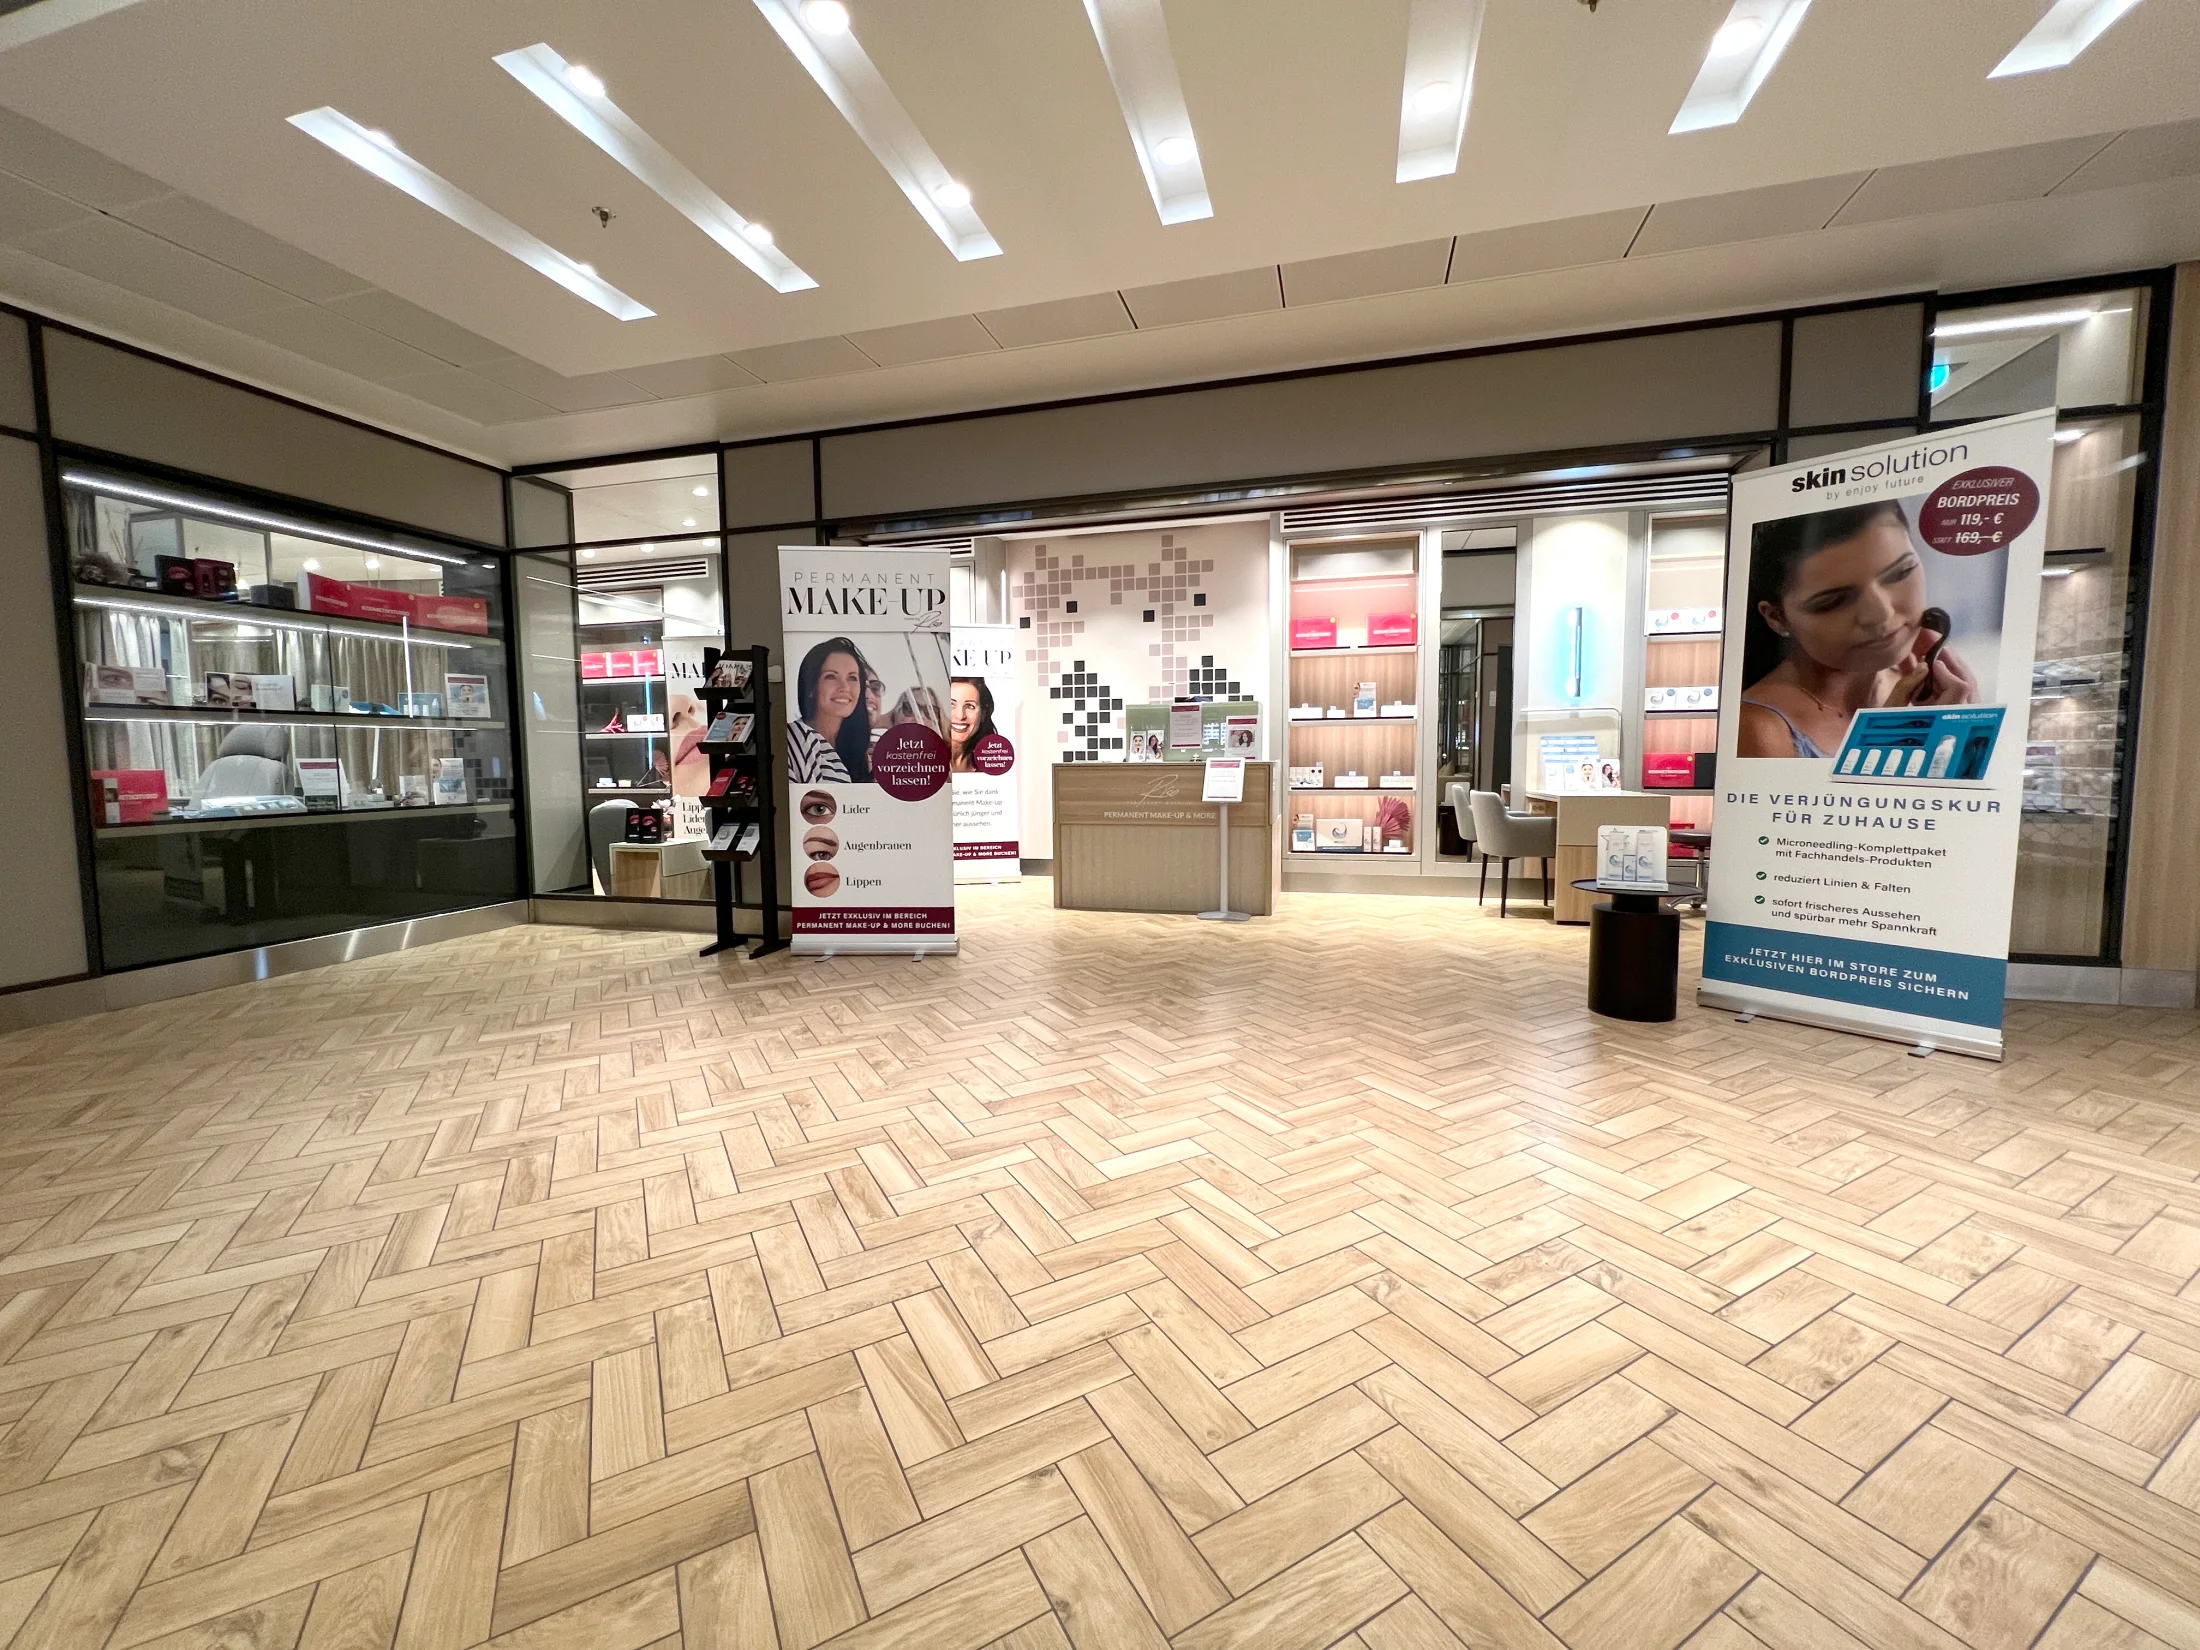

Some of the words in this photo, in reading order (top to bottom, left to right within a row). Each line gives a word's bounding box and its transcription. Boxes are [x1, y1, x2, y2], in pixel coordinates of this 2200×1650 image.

[1792, 467, 1846, 493] skin
[1851, 444, 1968, 482] solution
[1827, 491, 1840, 500] by
[1845, 483, 1879, 497] enjoy
[1885, 476, 1924, 489] future
[1952, 477, 2015, 490] EXKLUSIVER
[1937, 493, 2020, 508] BORDPREIS
[1993, 512, 2004, 525] €
[794, 572, 935, 584] PERMANENT
[787, 587, 946, 616] MAKE-UP
[896, 738, 924, 750] Jetzt
[885, 751, 936, 760] kostenfrei
[877, 762, 945, 773] vorzeichnen
[892, 775, 931, 785] lassen!
[842, 804, 870, 814] Lider
[1727, 793, 1759, 805] DIE
[1769, 793, 2001, 813] VERJÜNGUNGSKUR
[1772, 810, 1812, 824] FÜR
[1823, 814, 1937, 830] ZUHAUSE
[844, 841, 912, 852] Augenbrauen
[1776, 837, 1947, 857] Microneedling-Komplettpaket
[1775, 850, 1792, 858] mit
[1795, 850, 1932, 869] Fachhandels-Produkten
[846, 877, 881, 888] Lippen
[1773, 874, 1821, 886] reduziert
[1824, 878, 1858, 888] Linien
[1861, 882, 1870, 890] &
[1874, 882, 1911, 893] Falten
[1772, 898, 1802, 908] sofort
[1805, 900, 1859, 914] frischeres
[1861, 907, 1921, 921] Aussehen
[1771, 909, 1791, 918] und
[1794, 911, 1835, 924] spürbar
[1838, 917, 1868, 927] mehr
[1871, 920, 1937, 936] Spannkraft
[1749, 947, 1787, 961] JETZT
[1791, 954, 1823, 966] HIER
[1828, 959, 1844, 968] IM
[1850, 962, 1898, 977] STORE
[1903, 970, 1937, 982] ZUM
[1724, 954, 1804, 974] EXKLUSIVEN
[1809, 968, 1892, 988] BORDPREIS
[1897, 981, 1969, 1000] SICHERN
